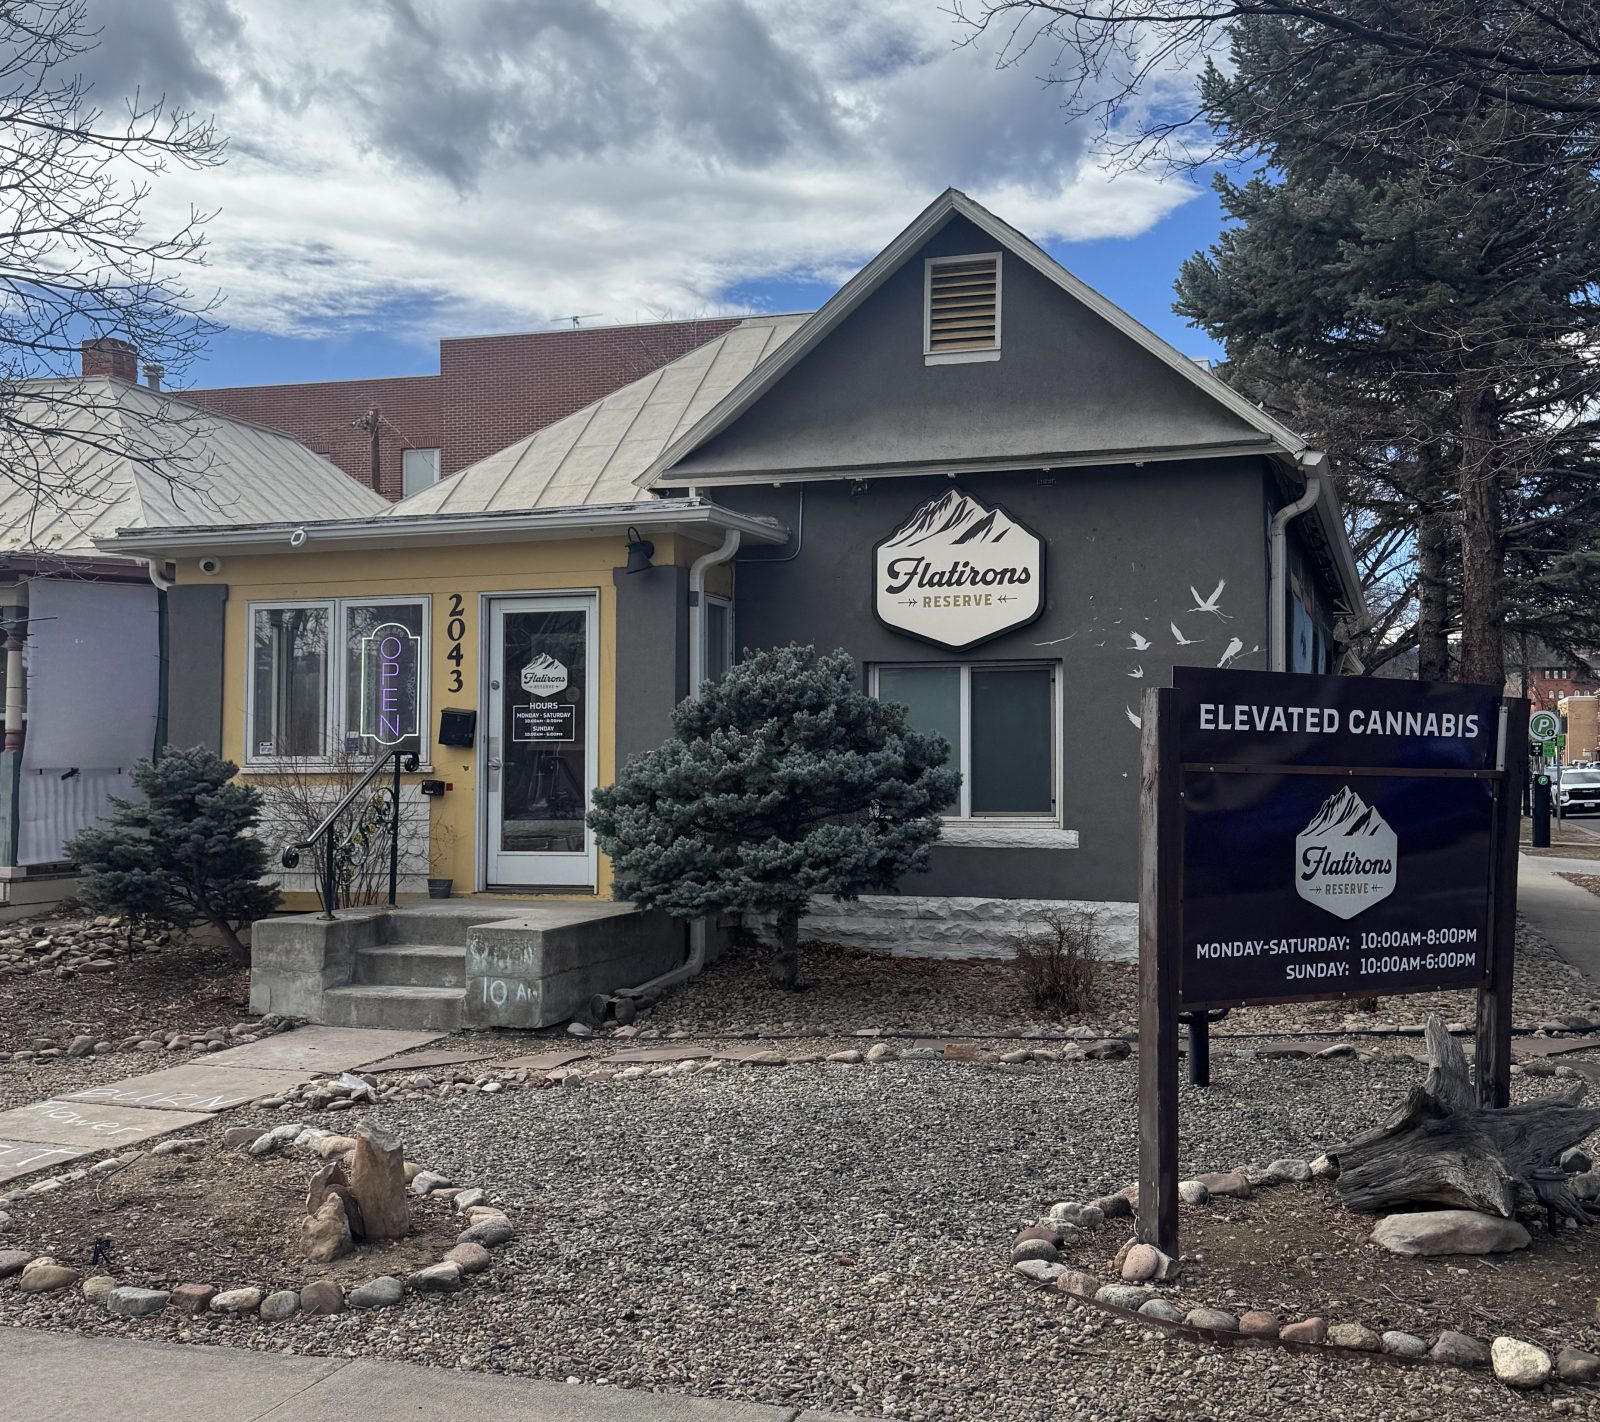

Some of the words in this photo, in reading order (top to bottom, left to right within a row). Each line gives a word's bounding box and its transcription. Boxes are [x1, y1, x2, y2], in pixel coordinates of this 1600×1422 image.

[885, 556, 1031, 594] Flatirons
[923, 594, 992, 608] RESERVE
[447, 593, 466, 693] 2043
[379, 636, 402, 737] OPEN
[523, 672, 566, 684] Flatirons
[529, 702, 558, 710] HOURS
[1199, 703, 1340, 734] ELEVATED
[1349, 709, 1479, 738] CANNABIS
[1537, 718, 1550, 733] P
[1300, 846, 1393, 881] Flatirons
[1325, 882, 1370, 896] RESERVE
[1196, 936, 1350, 959] MONDAY-SATURDAY:
[1360, 928, 1478, 950] 10:00AM-8:00PM
[1286, 961, 1350, 980] SUNDAY:
[1359, 952, 1476, 975] 10:00AM-6:00PM
[483, 976, 508, 1006] 10
[69, 1088, 250, 1108] BURN
[27, 1099, 144, 1135] Flower
